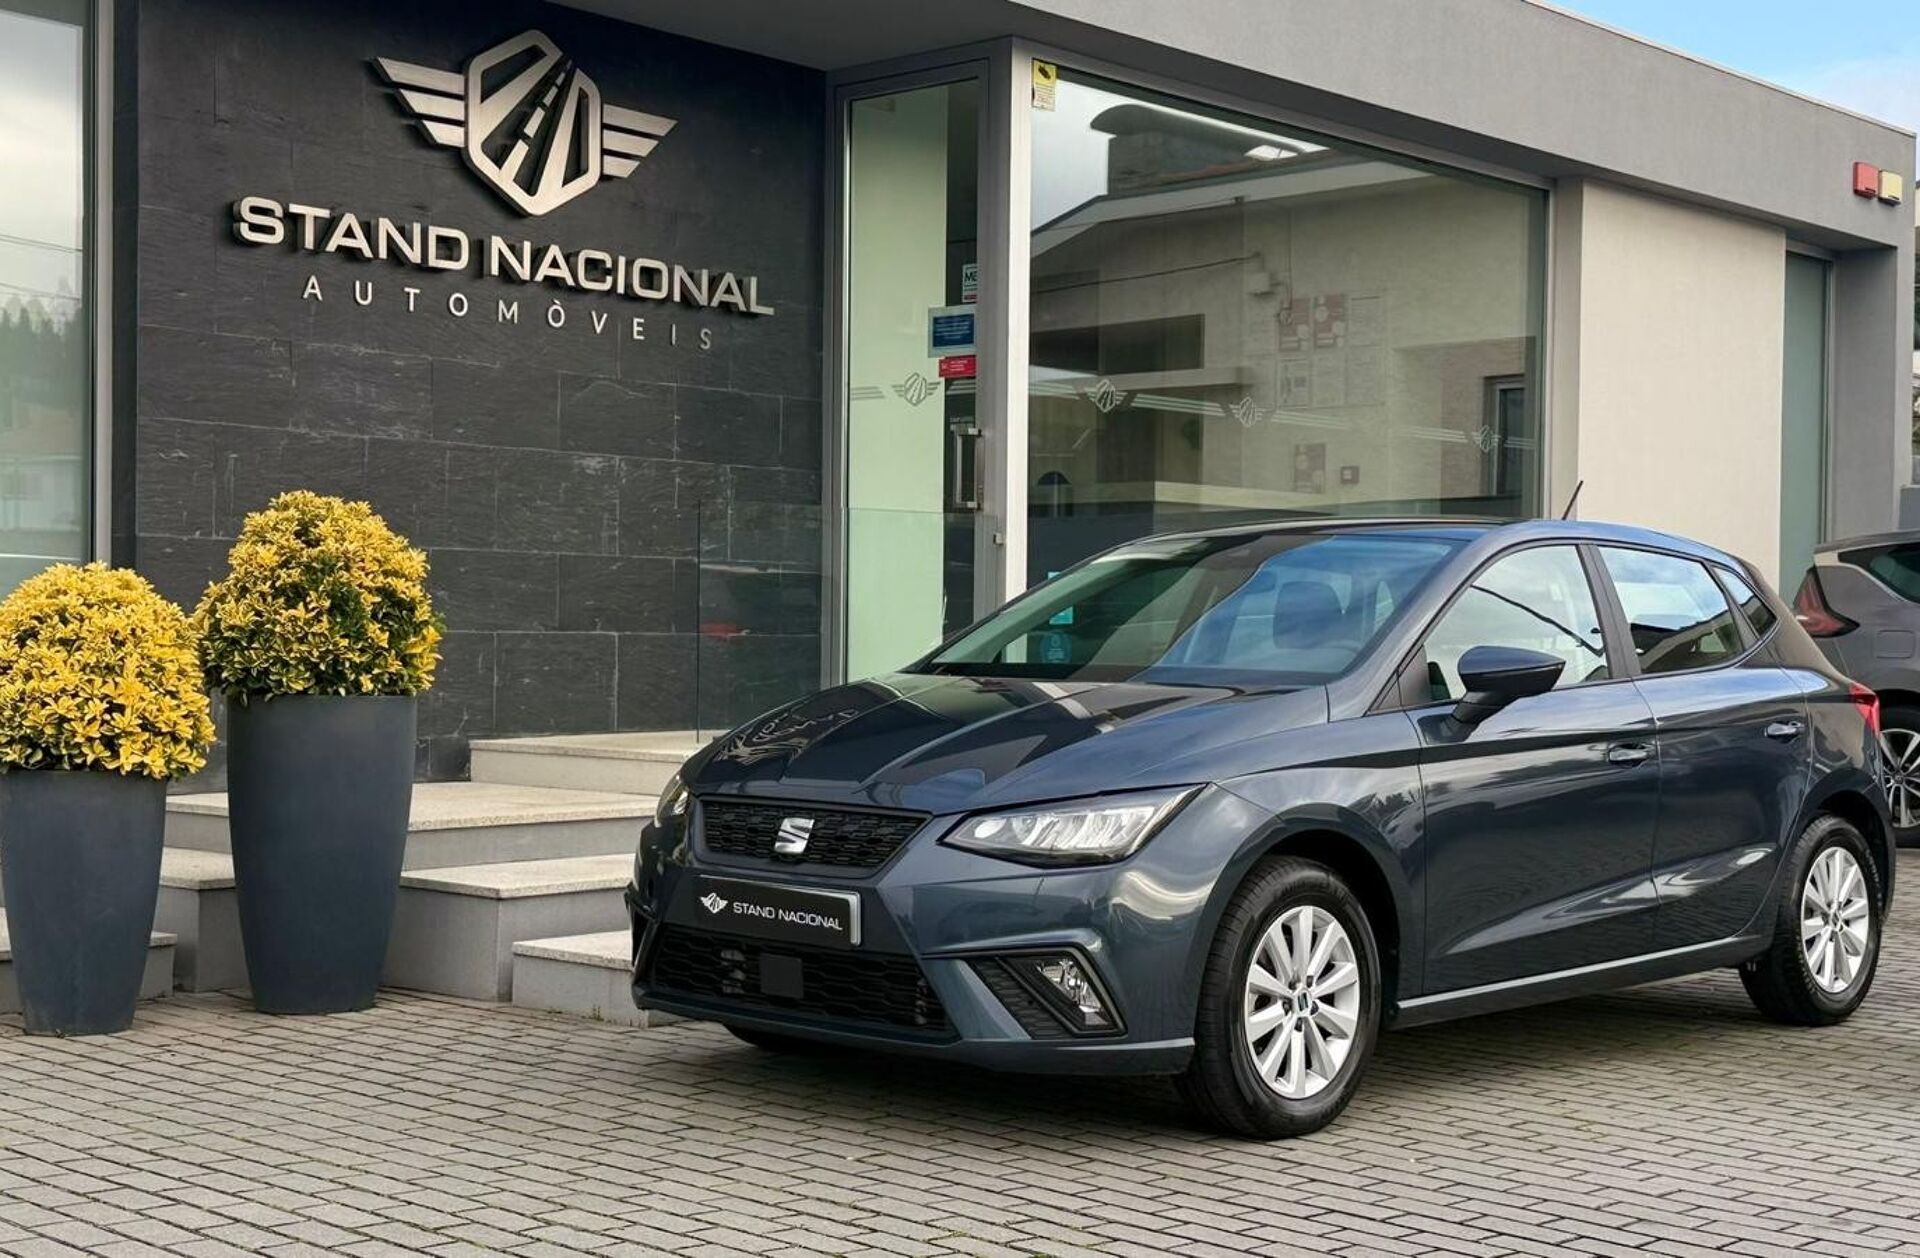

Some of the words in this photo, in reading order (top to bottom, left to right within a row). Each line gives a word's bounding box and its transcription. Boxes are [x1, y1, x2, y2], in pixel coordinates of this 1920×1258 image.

[236, 197, 469, 271] STAND
[489, 234, 775, 316] NACIONAL
[732, 902, 776, 919] STAND
[778, 909, 843, 930] NACIONAL
